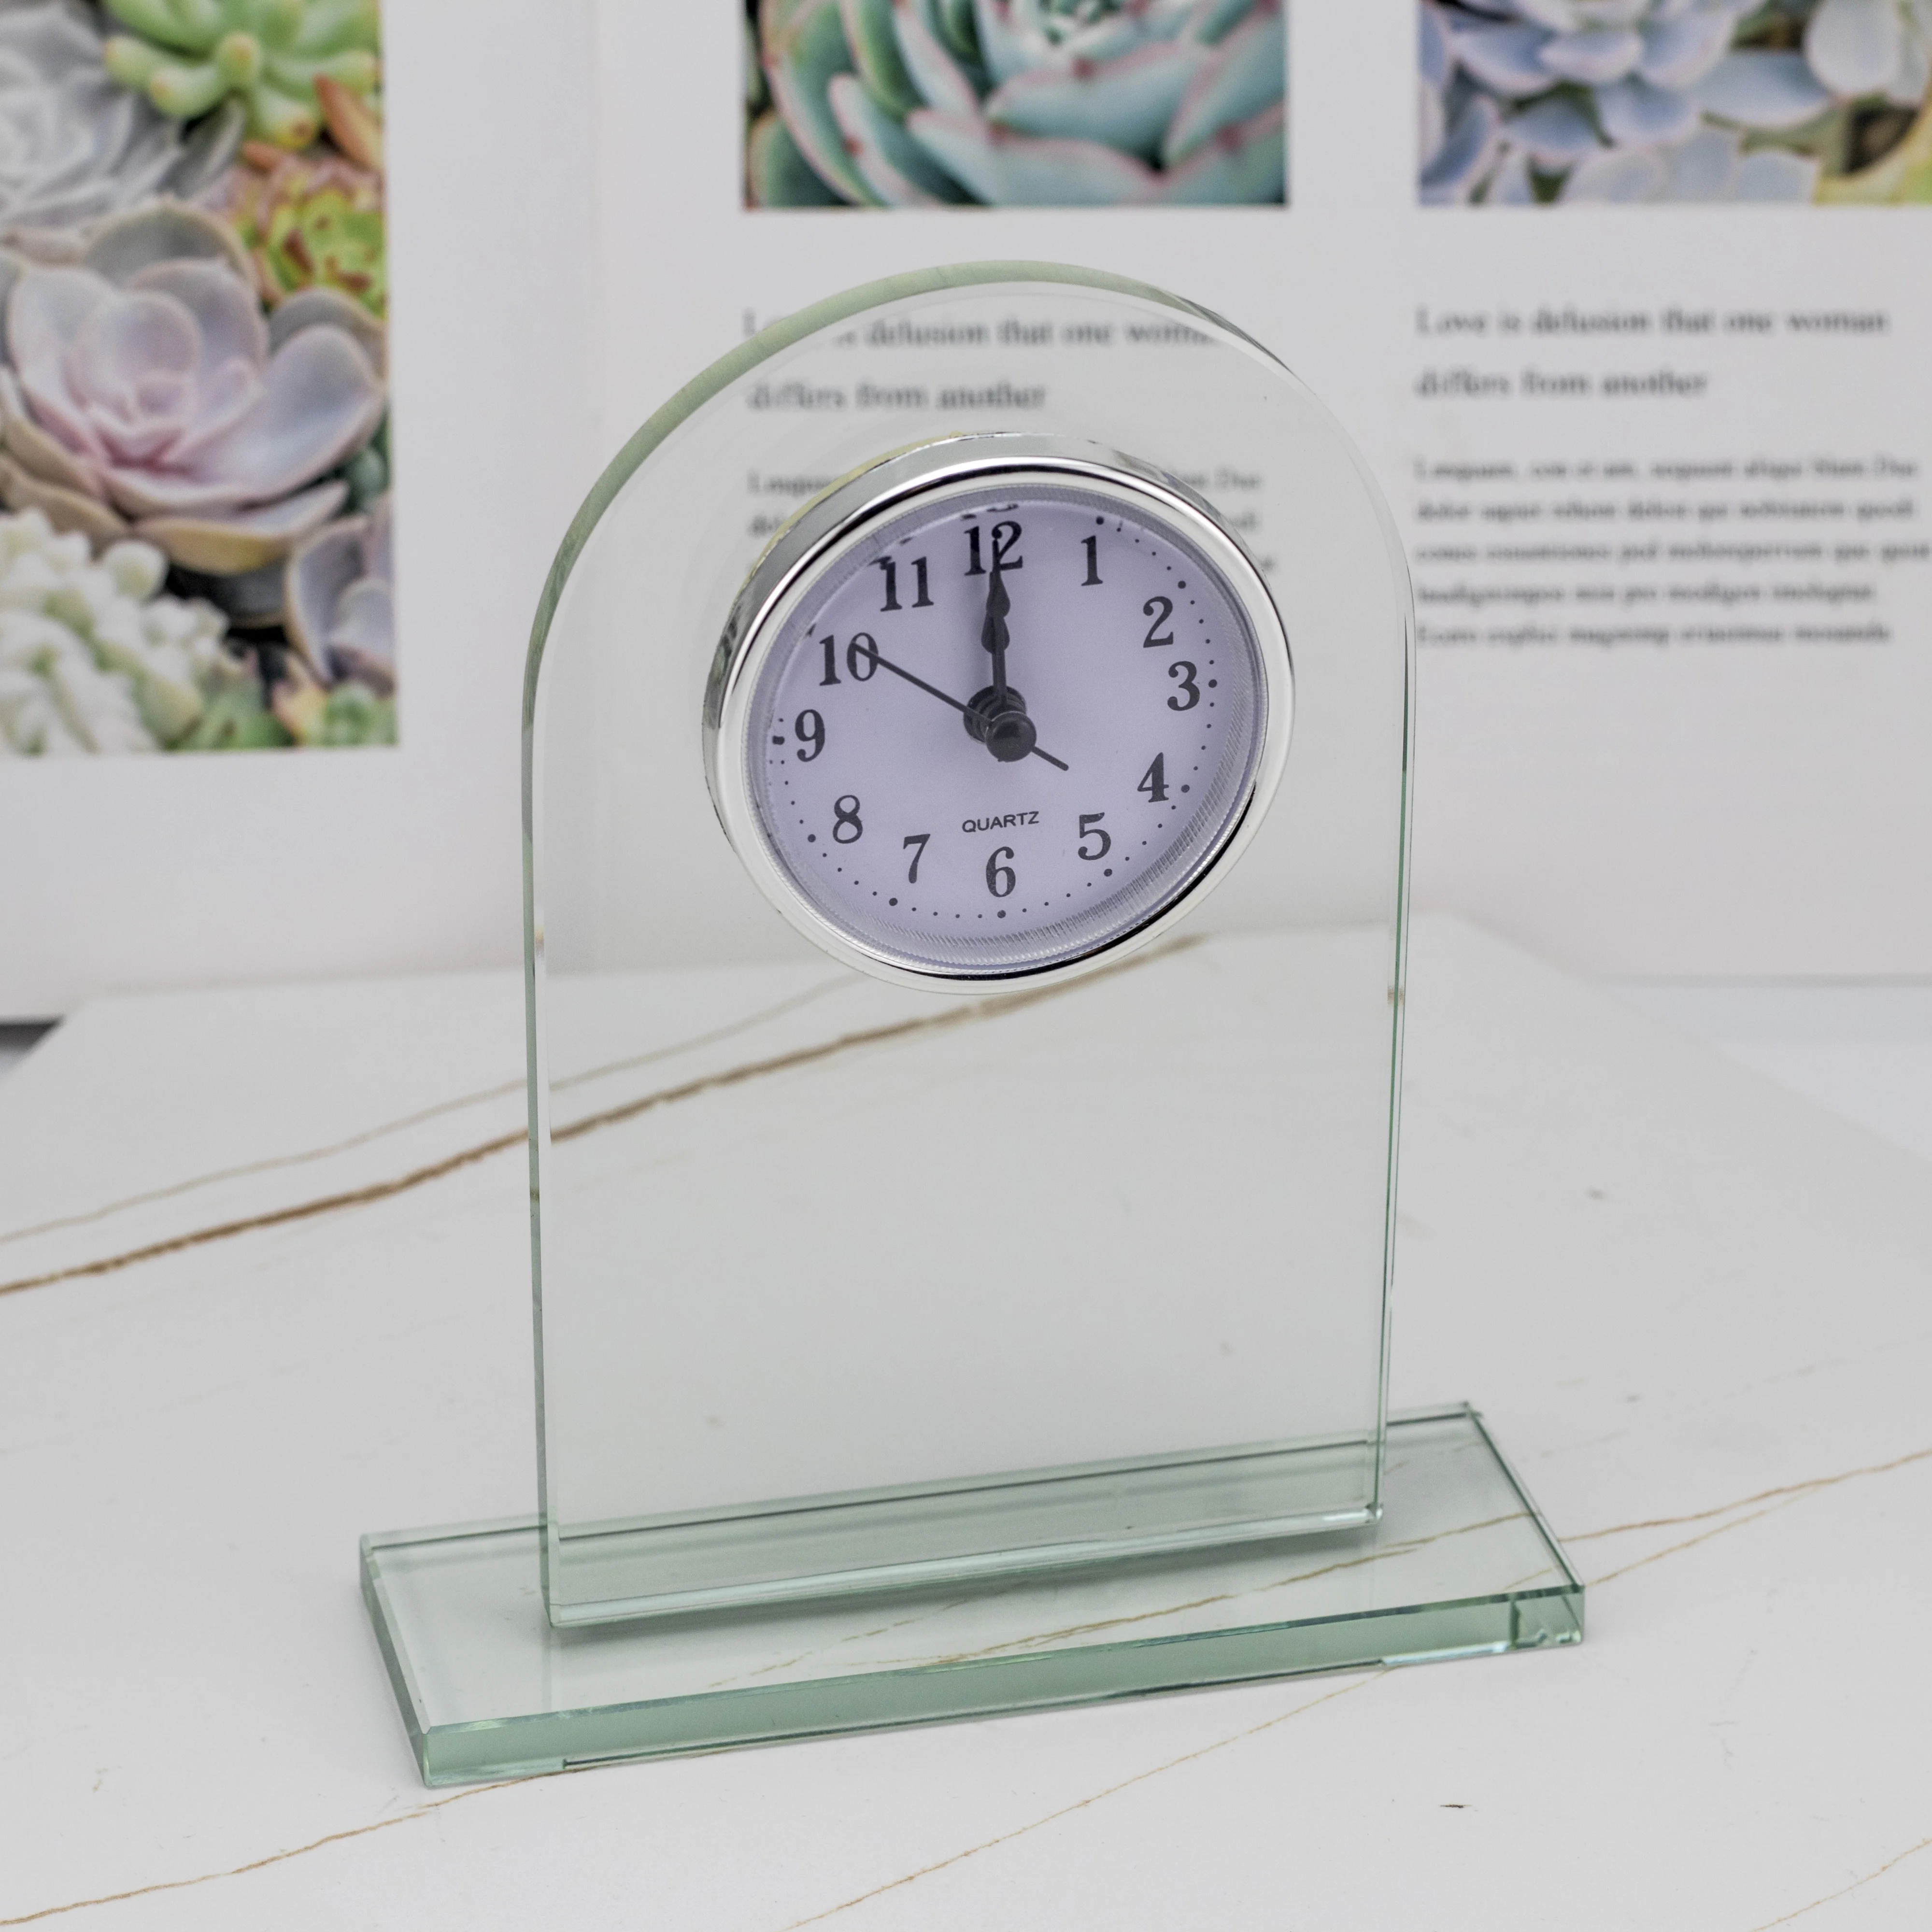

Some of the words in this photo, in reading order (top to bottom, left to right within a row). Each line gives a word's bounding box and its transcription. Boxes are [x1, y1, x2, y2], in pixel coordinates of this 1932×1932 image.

[1784, 311, 1890, 336] woman
[1600, 368, 1710, 398] another
[964, 520, 1023, 575] 12
[1081, 535, 1103, 586] 1
[869, 556, 934, 612] 11
[1143, 596, 1174, 648] 2
[819, 632, 879, 686] 10
[1167, 660, 1200, 711] 3
[795, 709, 825, 762] 9
[1137, 752, 1169, 803] 4
[832, 795, 863, 844] 8
[962, 811, 1039, 833] QUARTZ
[1078, 812, 1111, 861] 5
[903, 833, 931, 884] 7
[985, 846, 1016, 898] 6
